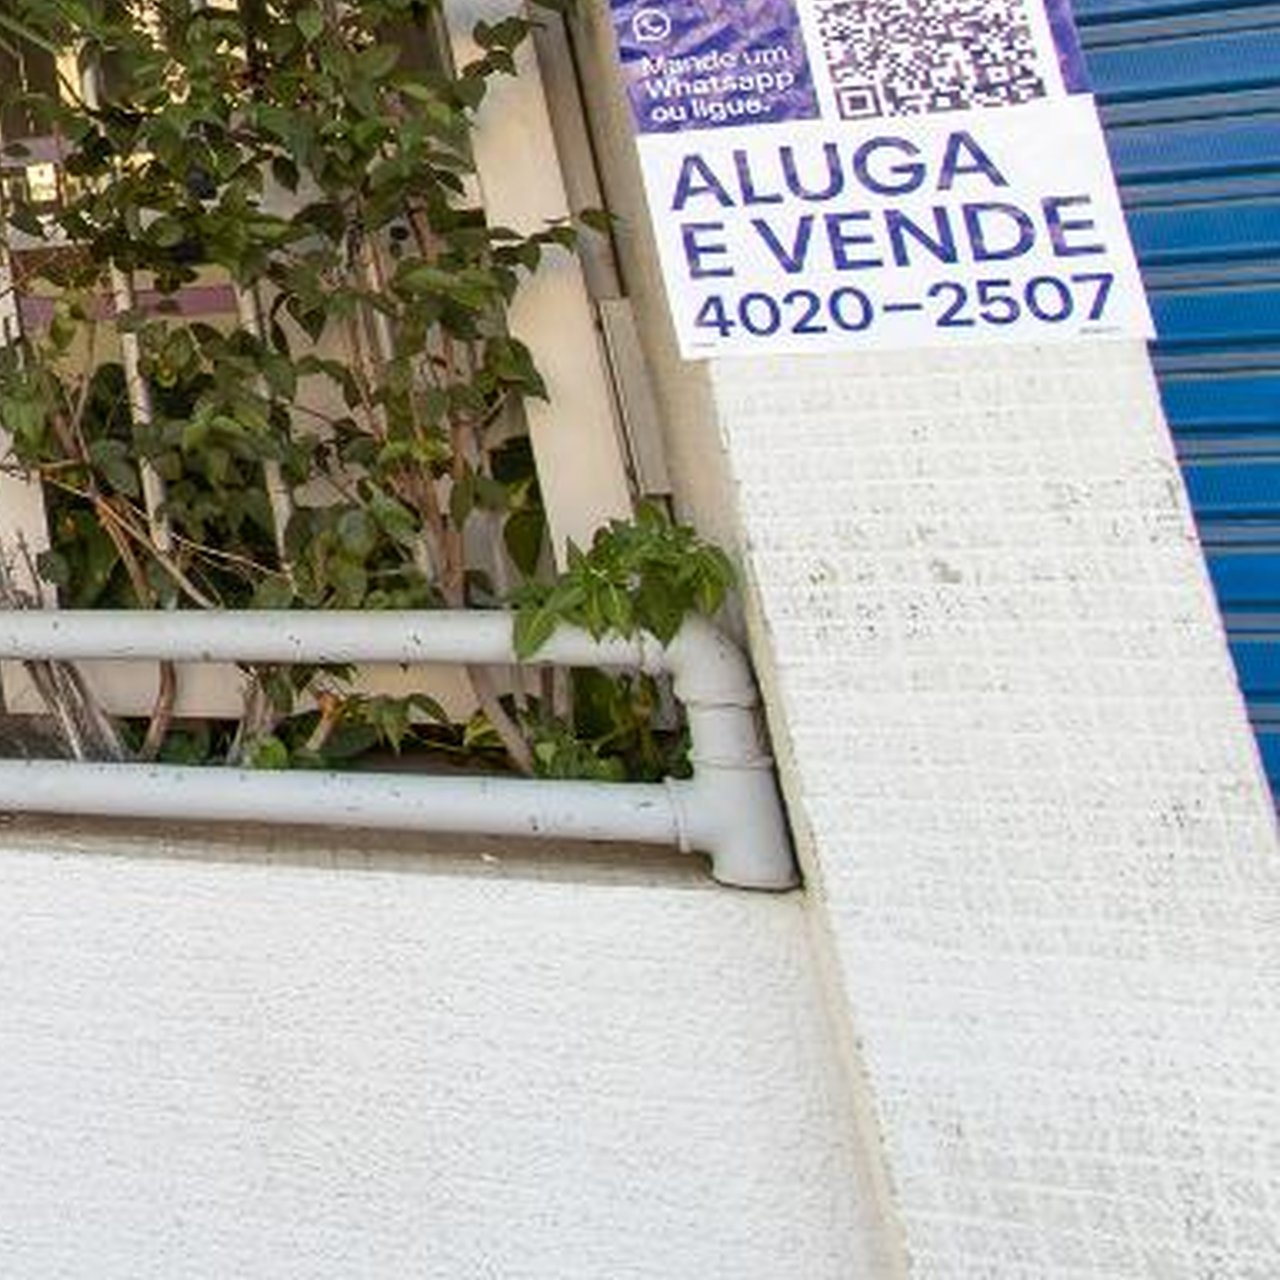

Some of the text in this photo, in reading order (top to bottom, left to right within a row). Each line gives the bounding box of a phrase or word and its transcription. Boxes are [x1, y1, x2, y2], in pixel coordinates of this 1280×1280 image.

[641, 45, 791, 75] Mande um
[645, 69, 795, 99] Whatsapp
[651, 98, 772, 122] ou ligue.
[670, 129, 1010, 211] ALUGA
[680, 195, 1107, 279] E VENDE
[694, 272, 1115, 338] 4020-2507
